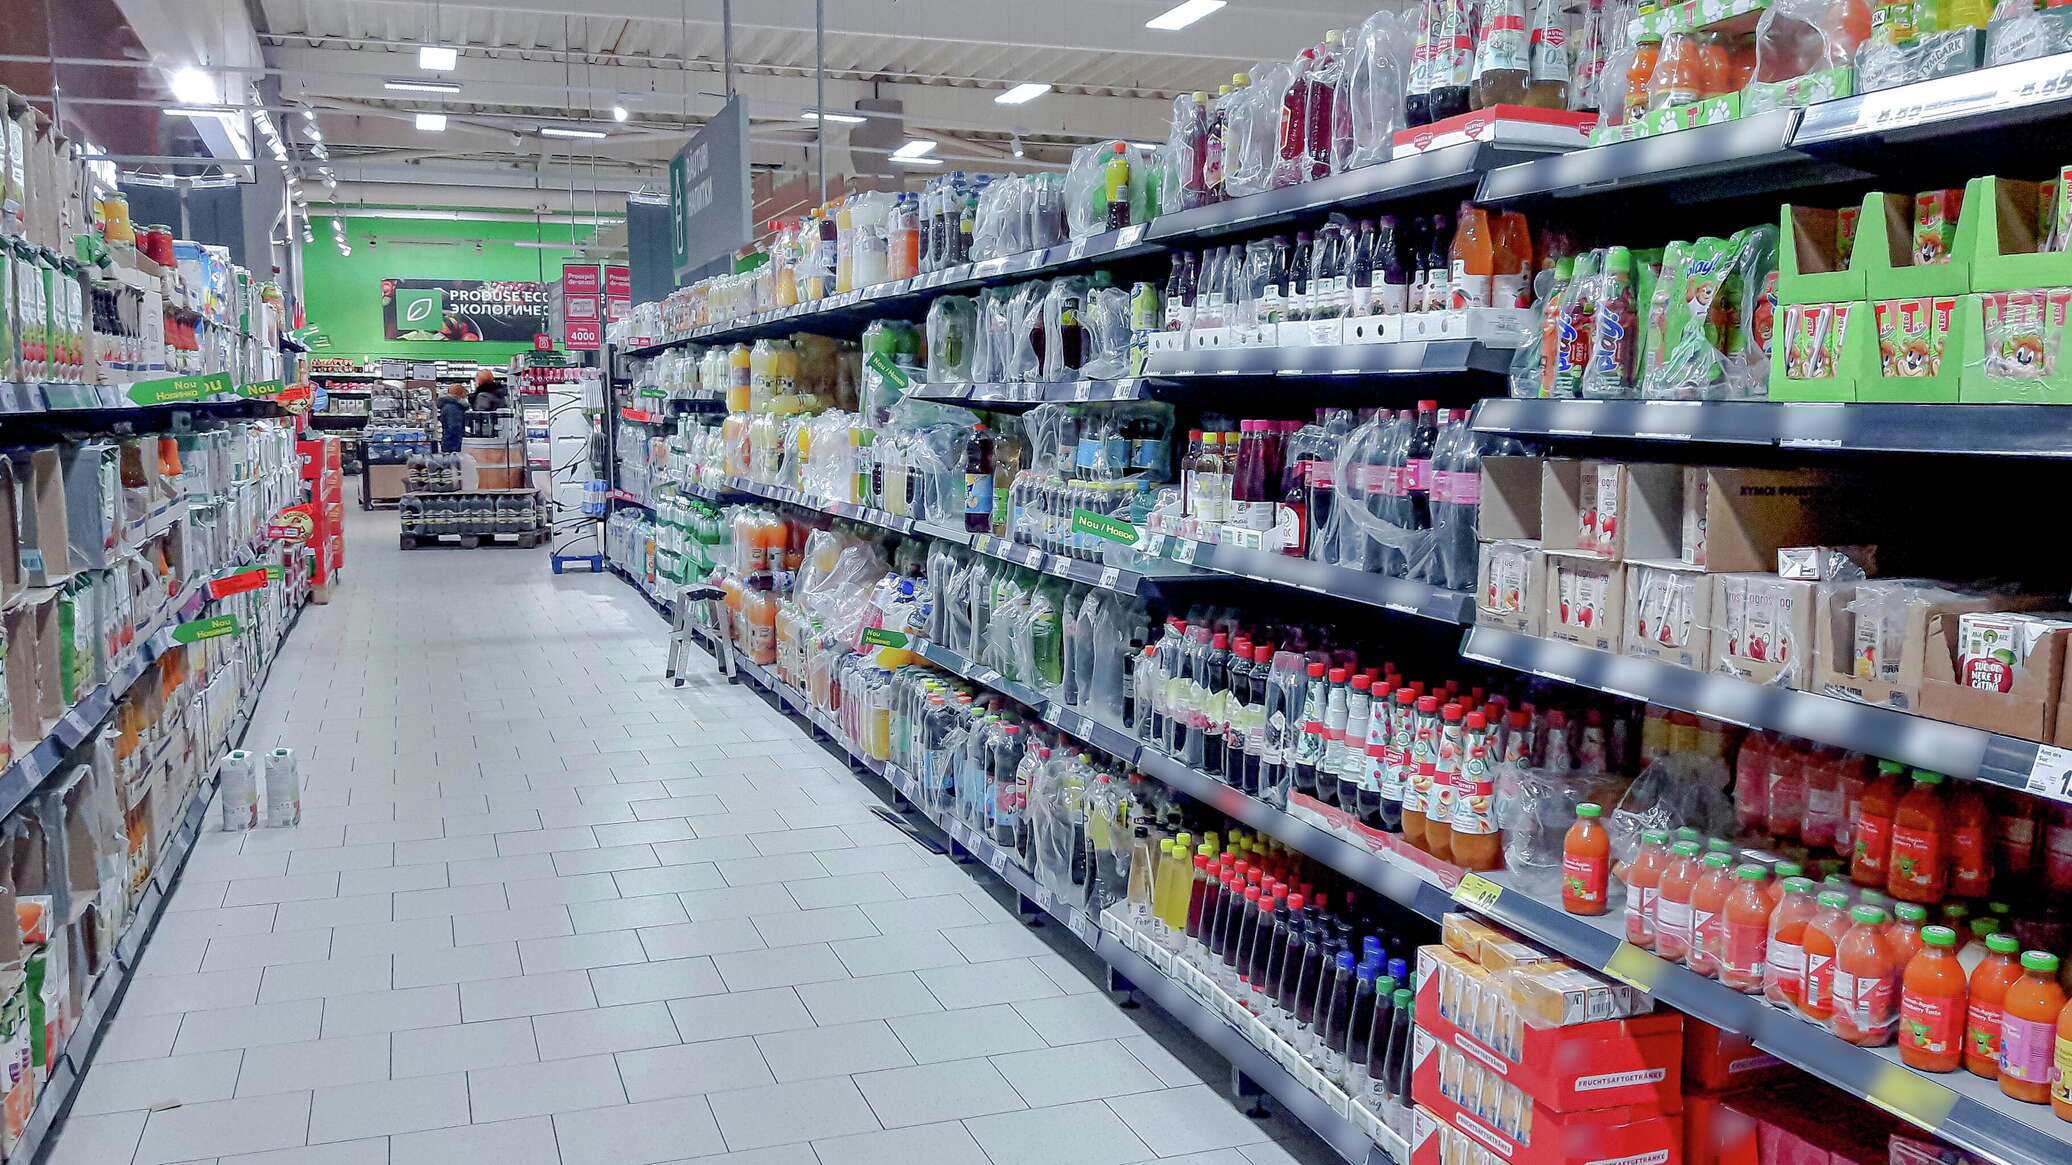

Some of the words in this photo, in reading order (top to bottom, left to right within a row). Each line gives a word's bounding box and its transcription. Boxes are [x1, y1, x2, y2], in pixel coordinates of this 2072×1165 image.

[450, 291, 519, 303] PRODUSE
[571, 332, 595, 341] 4000
[174, 381, 197, 391] Nou
[248, 384, 275, 396] Nou
[1078, 516, 1099, 532] Nou
[212, 619, 231, 628] Nou
[866, 629, 881, 637] Nou
[2060, 769, 2072, 797] 1
[1578, 1070, 1663, 1089] FRUCHTSAFTGETRÄNKE
